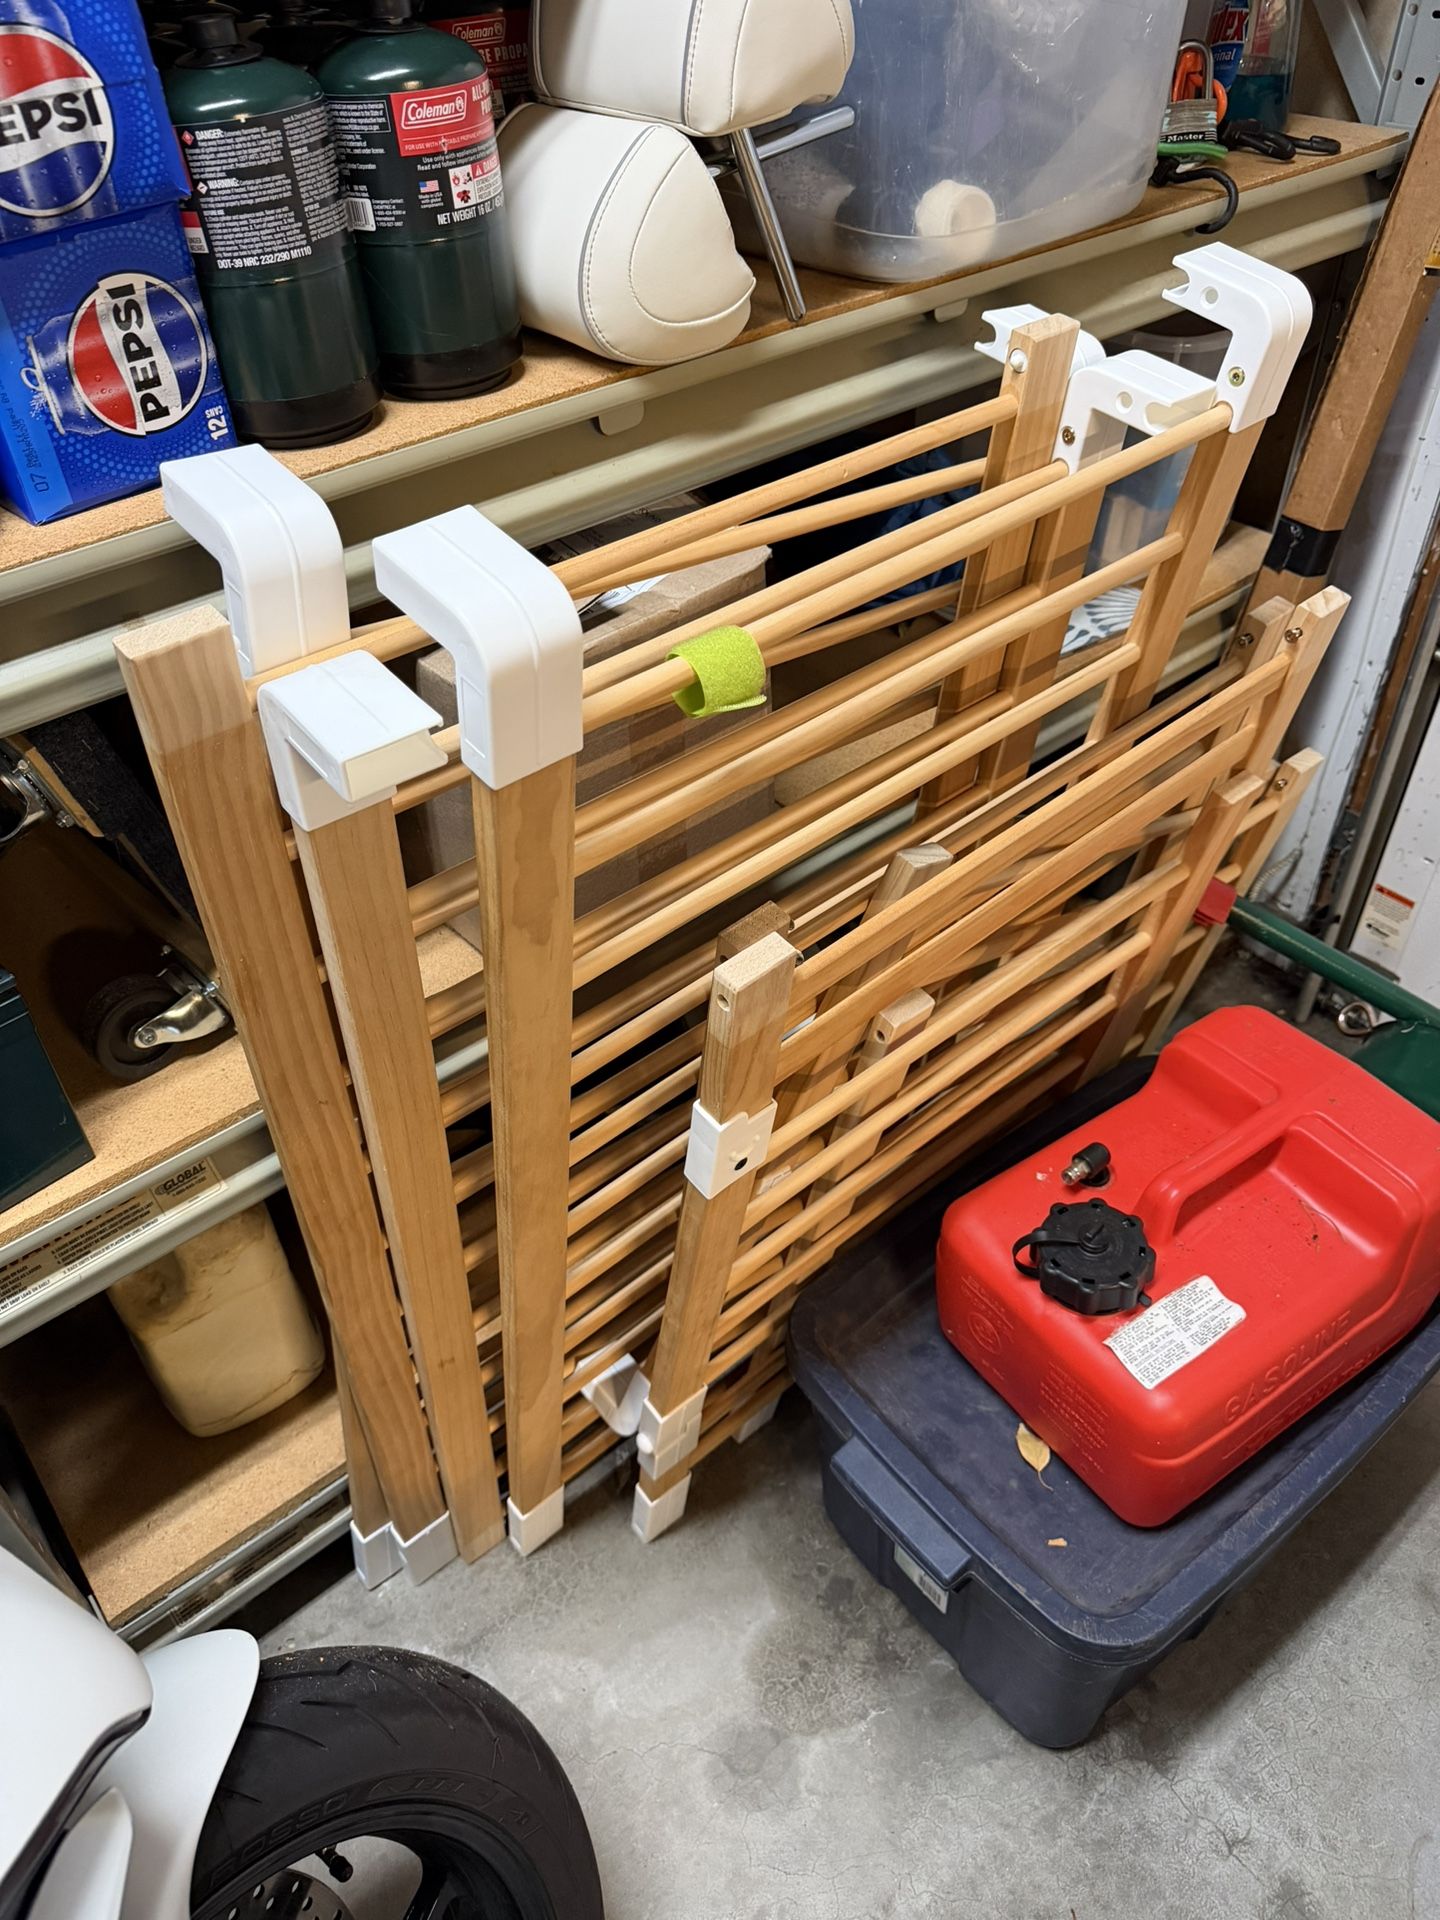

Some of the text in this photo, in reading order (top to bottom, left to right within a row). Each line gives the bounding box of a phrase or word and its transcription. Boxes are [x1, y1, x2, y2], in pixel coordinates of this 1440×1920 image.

[495, 42, 528, 62] PROPA
[0, 88, 102, 146] EPSI
[408, 102, 455, 120] Coleman
[195, 128, 224, 140] DANGER:
[1167, 133, 1204, 142] Master
[417, 163, 431, 171] Read
[441, 158, 456, 167] follow
[433, 154, 444, 162] only
[207, 178, 240, 189] WARNING:
[437, 212, 451, 226] NET
[452, 208, 476, 223] WEIGHT
[478, 204, 485, 216] 16
[217, 246, 312, 269] DOT-39 NRC 232/290 M1110
[105, 283, 170, 422] PEPSI
[205, 405, 223, 418] CANS
[208, 415, 228, 440] 12
[29, 472, 50, 492] 07
[164, 1163, 206, 1191] GLOBAL
[1225, 1310, 1351, 1422] GASOLINE
